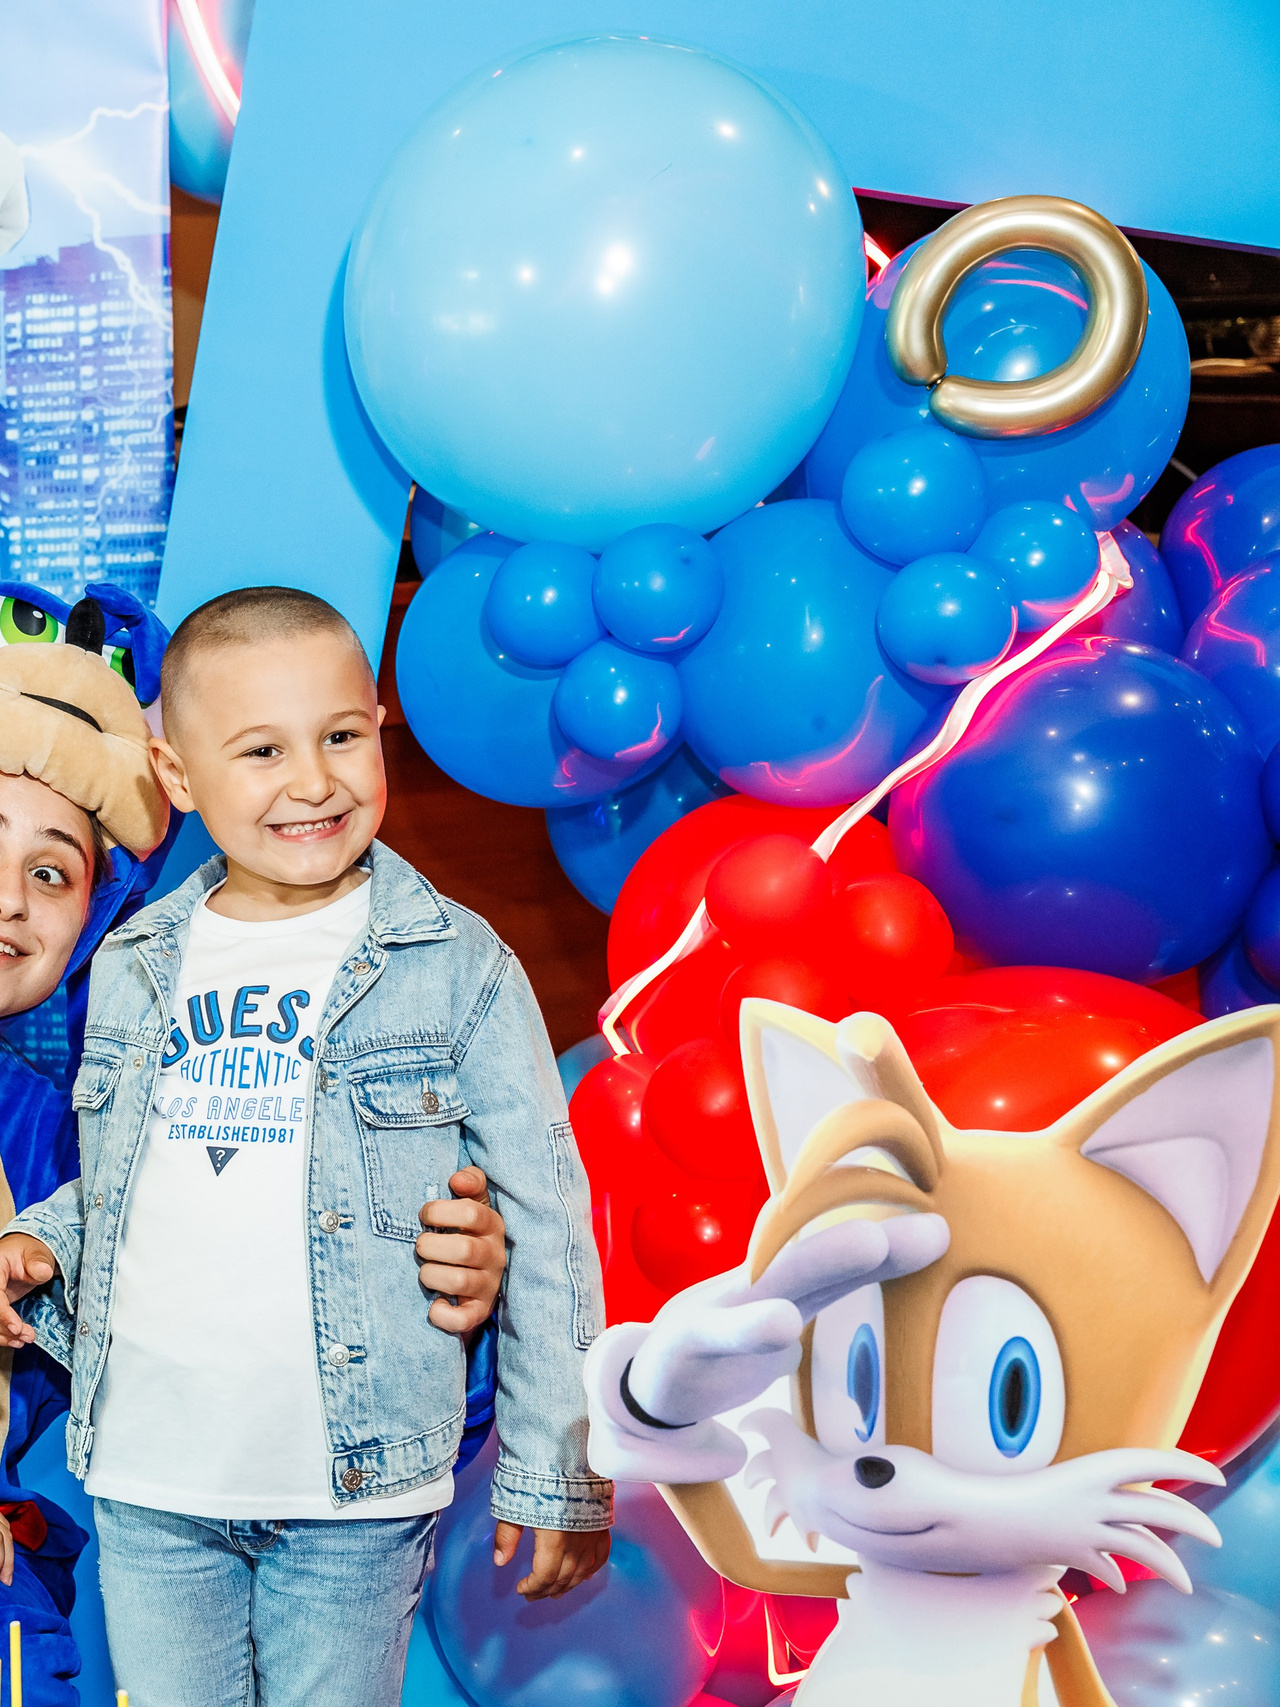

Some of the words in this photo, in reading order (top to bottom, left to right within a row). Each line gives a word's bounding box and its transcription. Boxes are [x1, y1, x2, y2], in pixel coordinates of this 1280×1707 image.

[180, 1046, 302, 1089] AUTHENTIC
[158, 1096, 198, 1120] LOS
[206, 1095, 307, 1122] ANGELE
